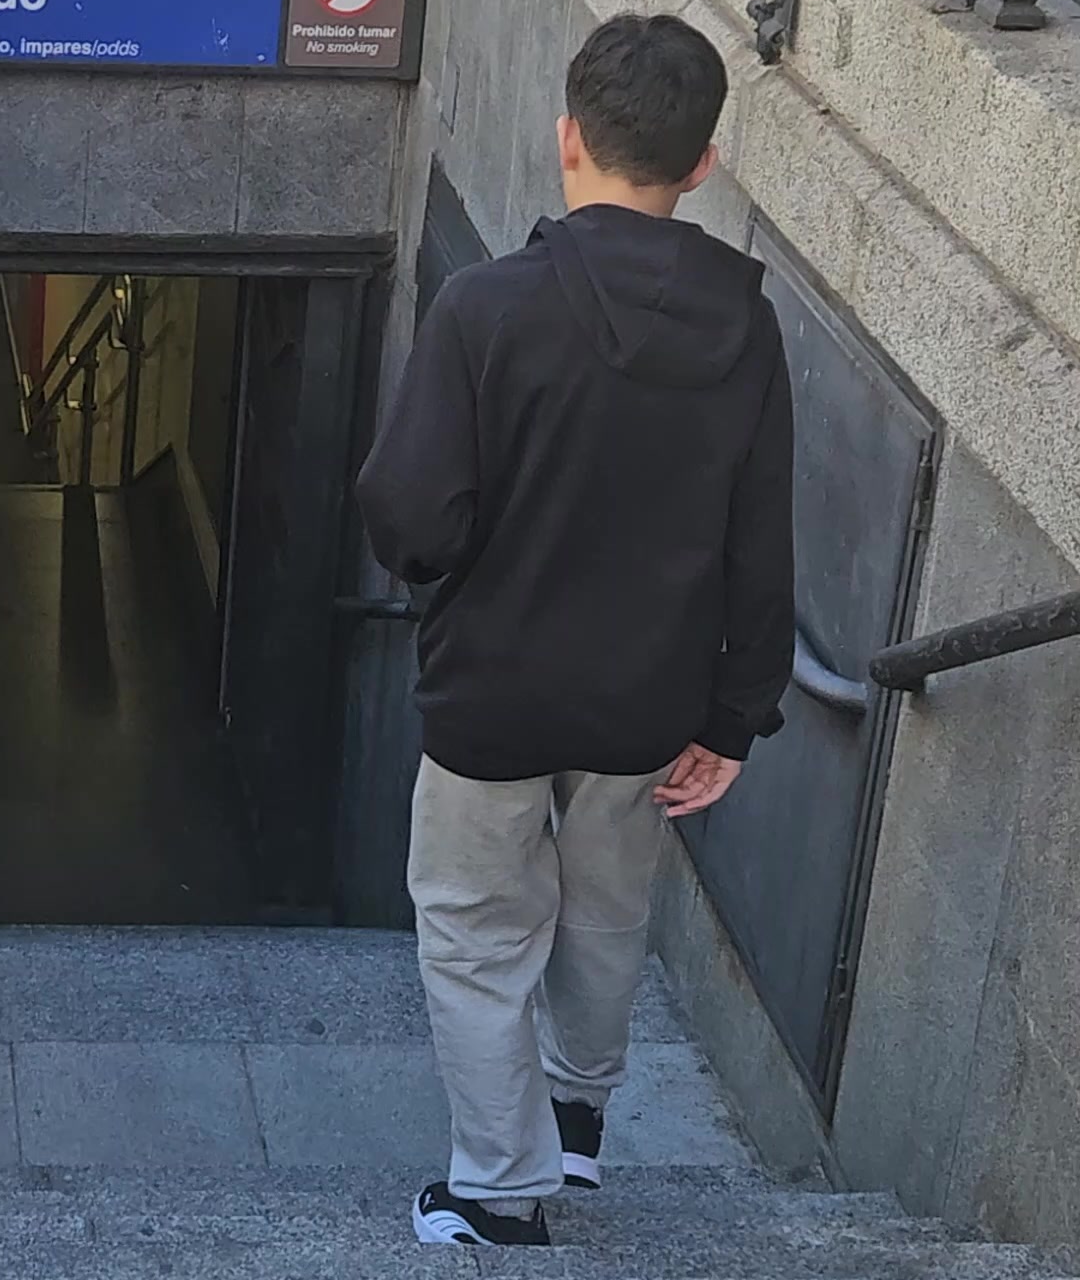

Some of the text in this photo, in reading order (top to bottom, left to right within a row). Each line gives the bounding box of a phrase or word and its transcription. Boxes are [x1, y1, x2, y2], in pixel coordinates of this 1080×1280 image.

[292, 24, 397, 38] Prohibido fumar
[20, 38, 140, 58] impares/odds
[306, 40, 379, 57] No smoking
